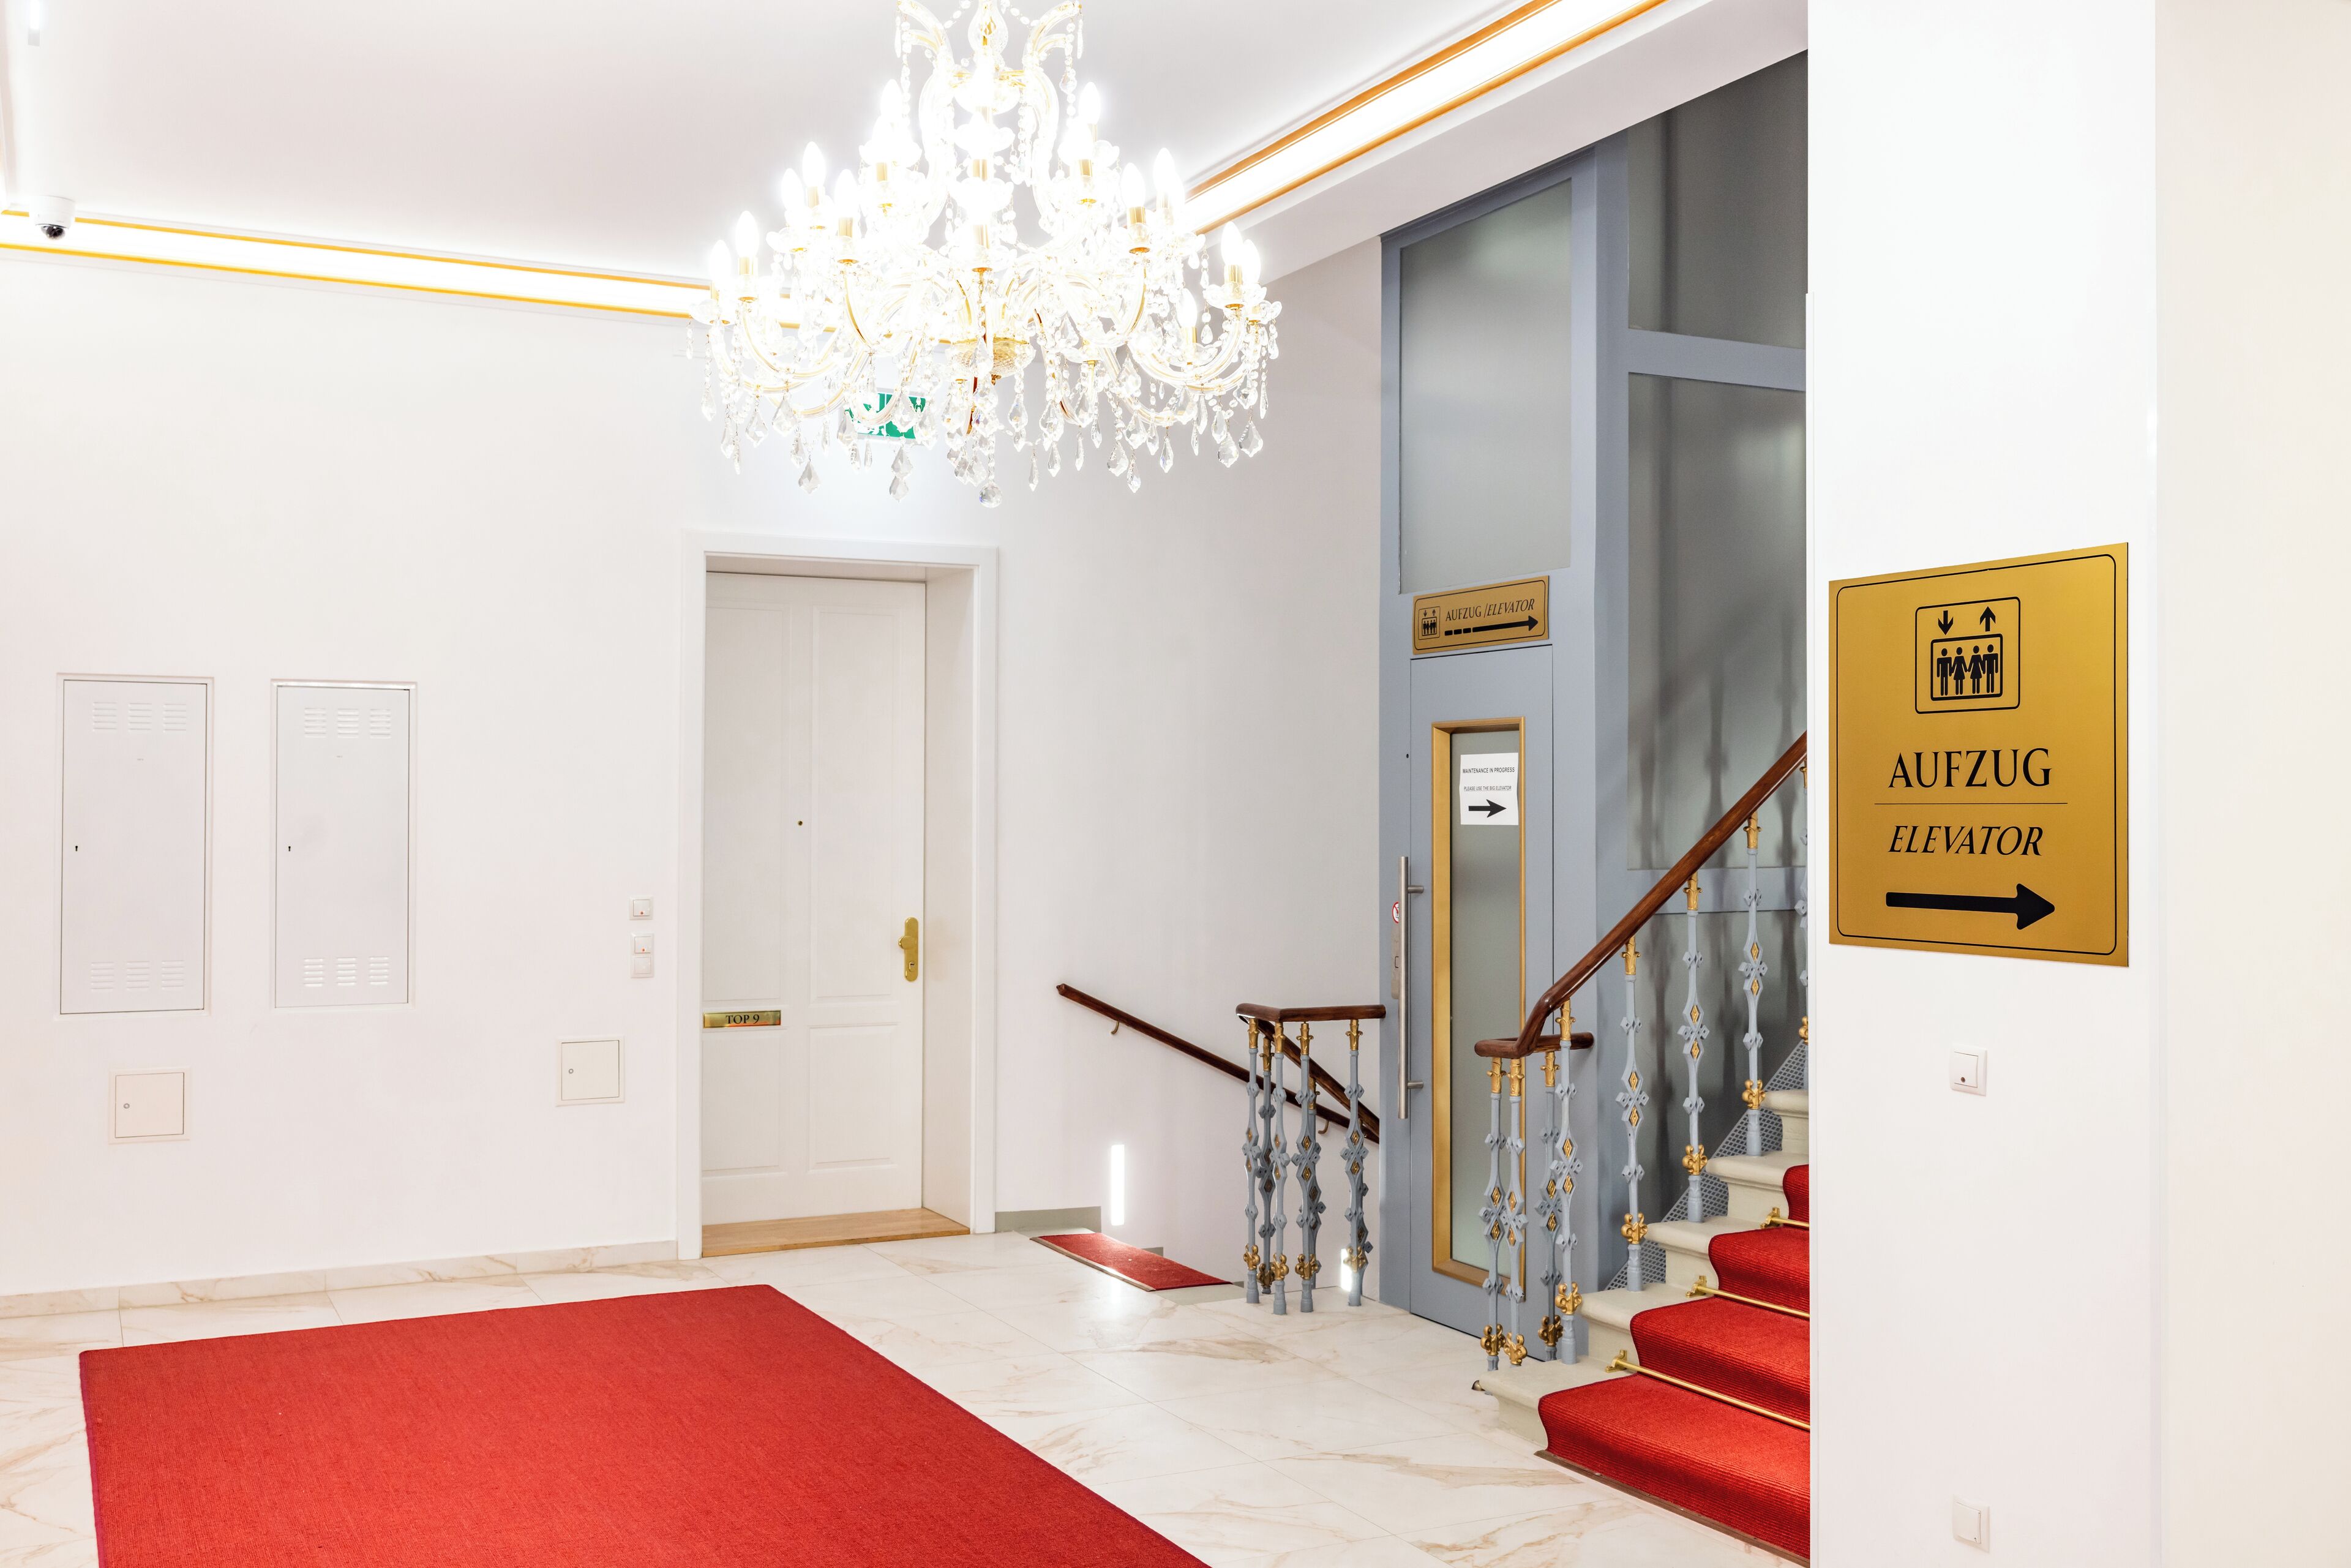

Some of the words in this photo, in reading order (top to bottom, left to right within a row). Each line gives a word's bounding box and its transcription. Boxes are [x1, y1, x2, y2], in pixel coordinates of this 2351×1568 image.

[1445, 606, 1482, 621] AUFZUG
[1888, 748, 2053, 789] AUFZUG
[1888, 825, 2044, 857] ELEVATOR
[725, 1015, 749, 1024] TOP
[753, 1014, 760, 1024] 9
